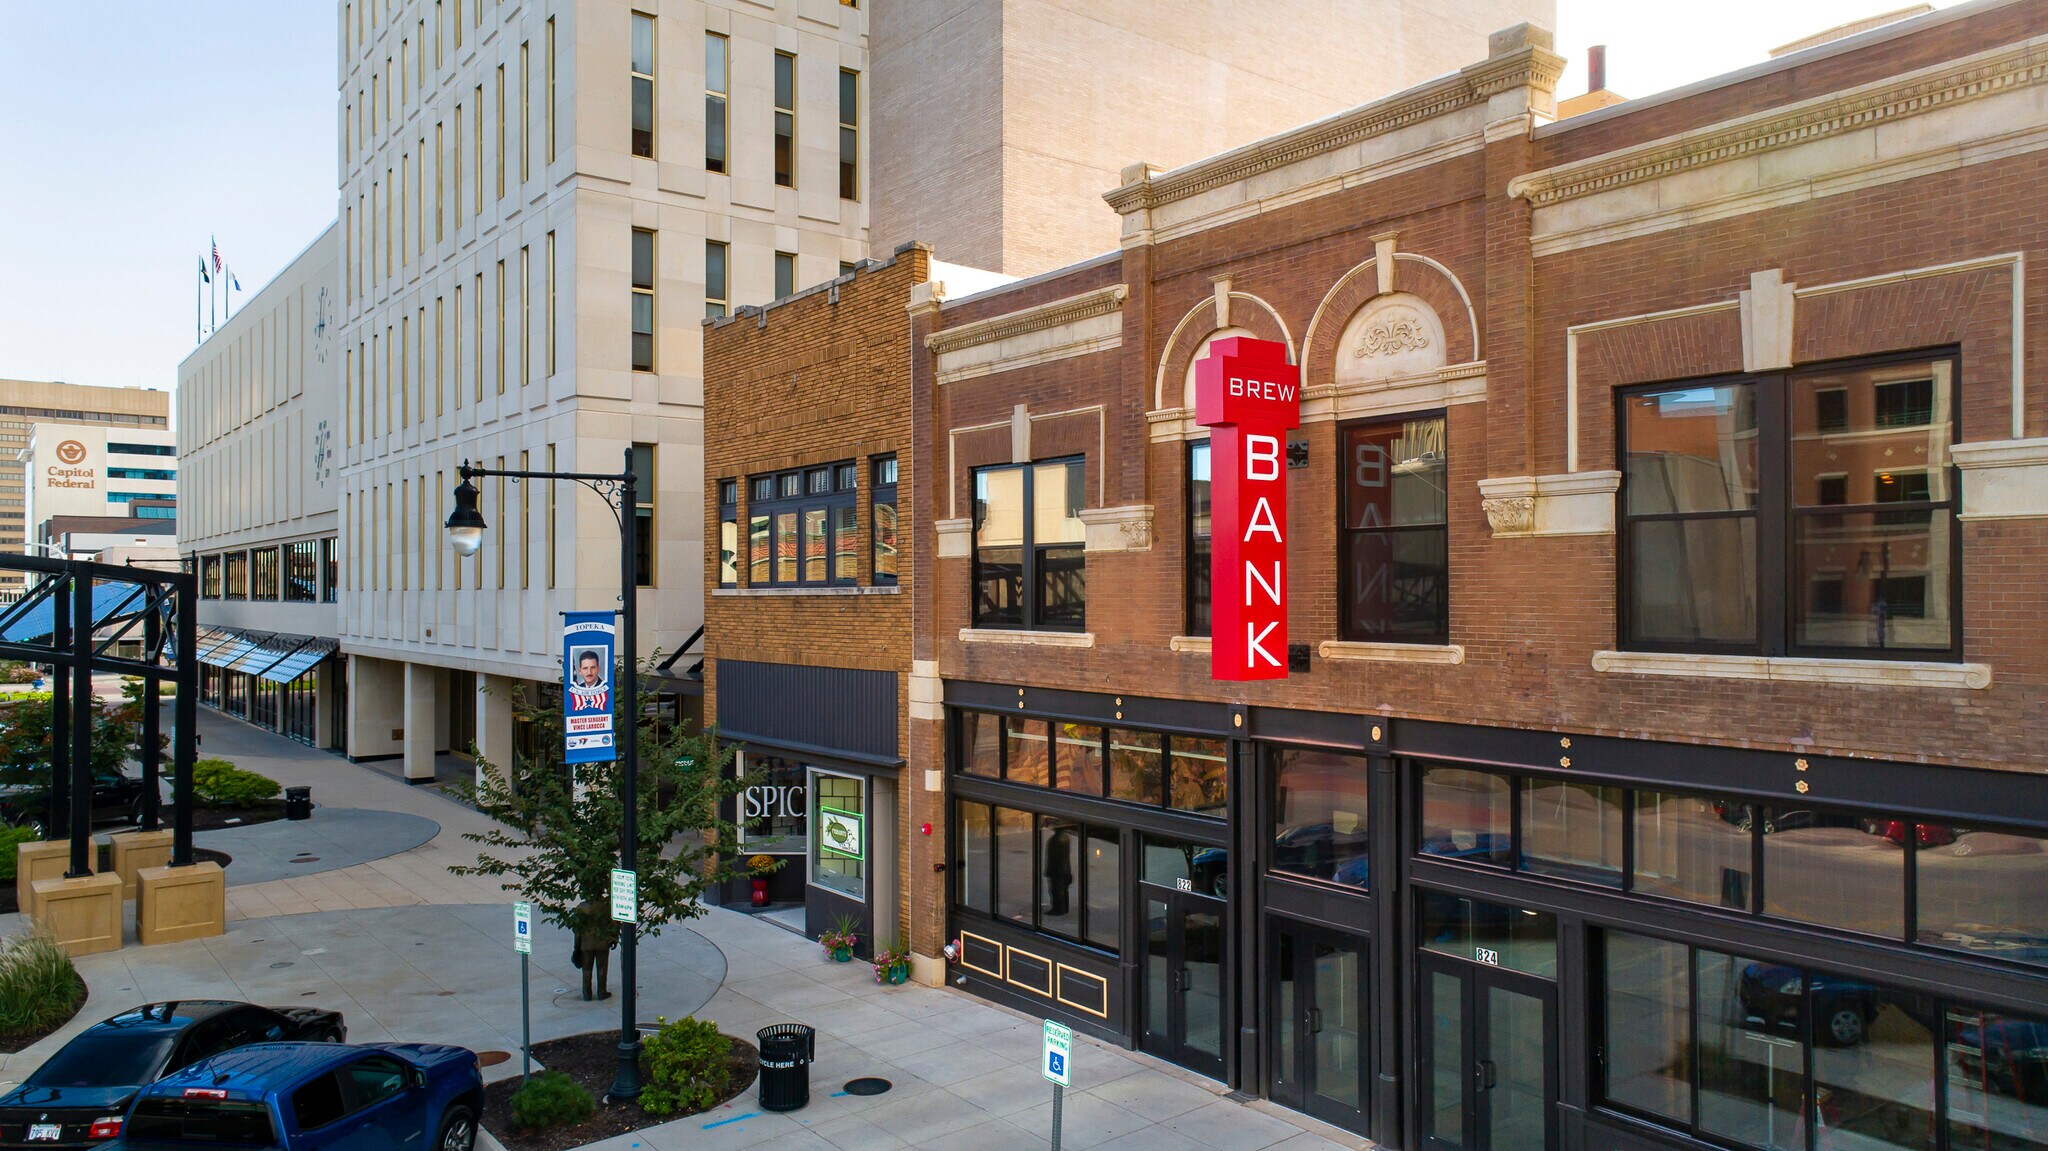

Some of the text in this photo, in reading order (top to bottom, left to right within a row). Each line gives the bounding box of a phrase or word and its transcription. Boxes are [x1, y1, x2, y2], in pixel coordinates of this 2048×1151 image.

[1230, 377, 1295, 402] BREW
[47, 466, 94, 478] Capitol
[47, 478, 95, 489] Federal
[1243, 434, 1283, 668] BANK
[570, 717, 587, 725] MASTER
[586, 722, 605, 730] LAROCCA
[745, 786, 807, 817] SPIC
[1177, 878, 1191, 891] 822
[1477, 948, 1497, 964] 824
[1046, 1025, 1069, 1041] RESERVED
[1047, 1036, 1068, 1050] PARKING
